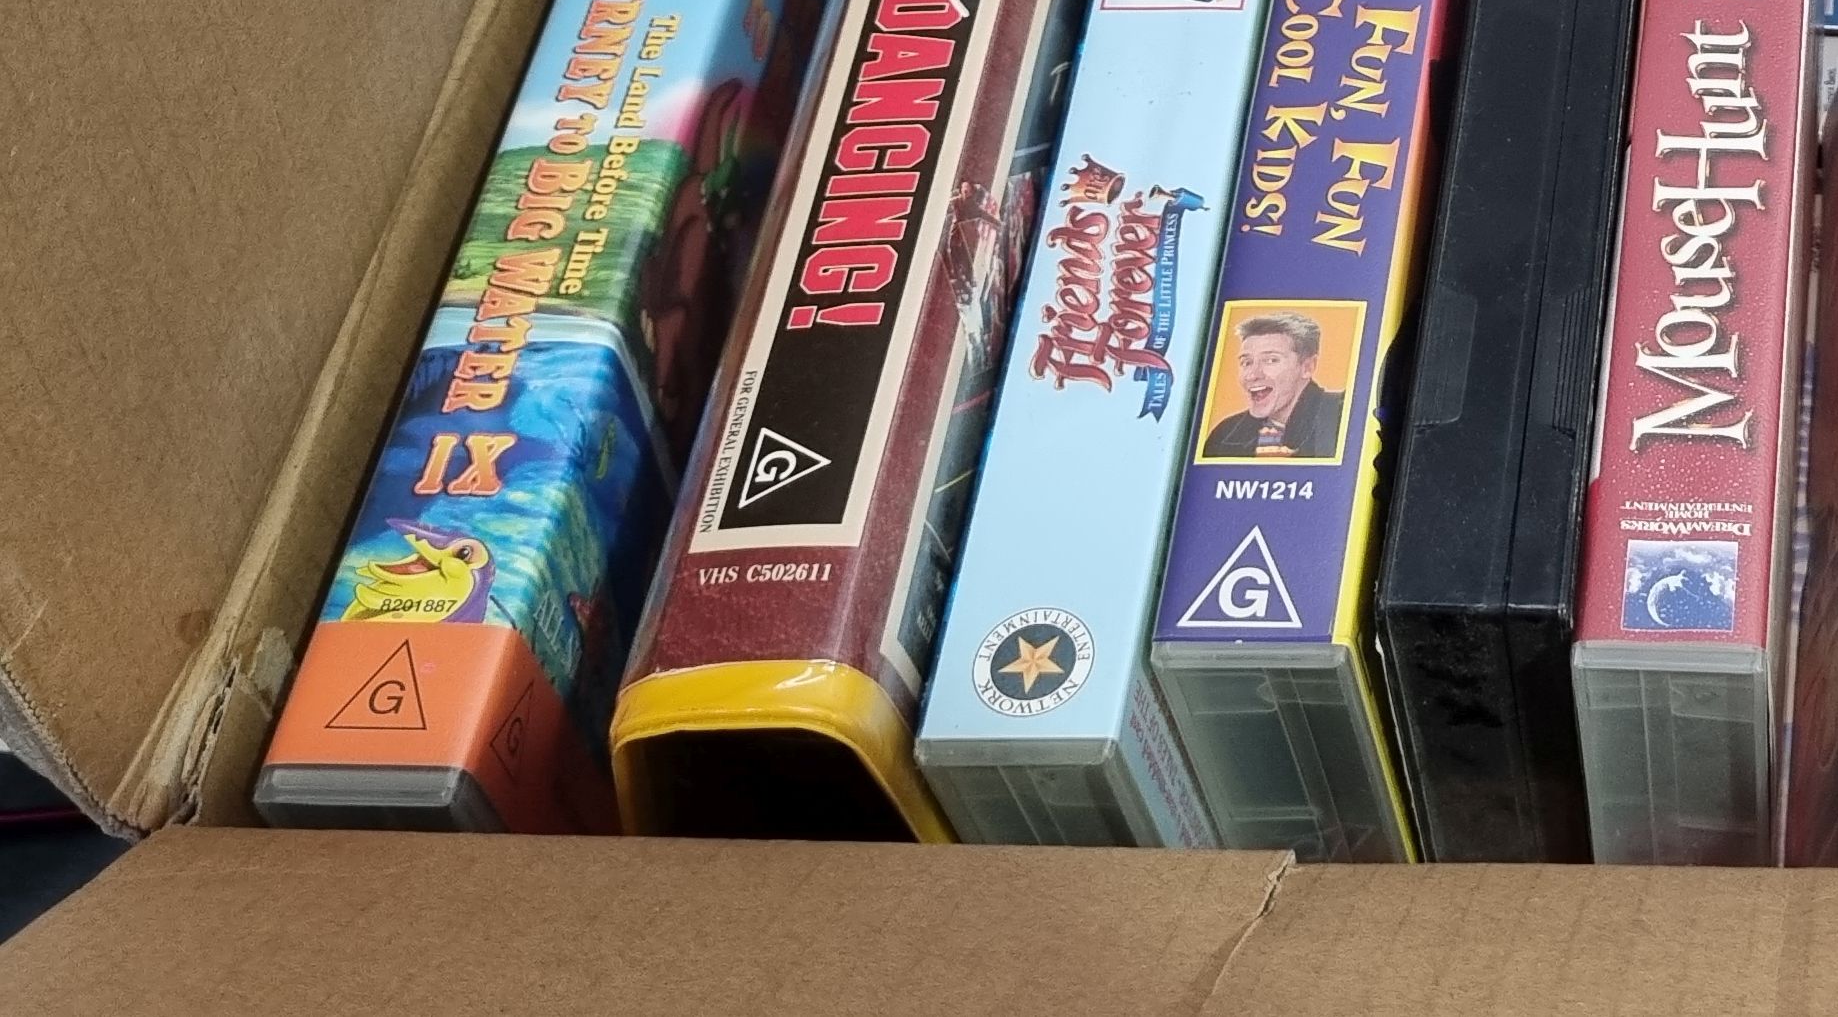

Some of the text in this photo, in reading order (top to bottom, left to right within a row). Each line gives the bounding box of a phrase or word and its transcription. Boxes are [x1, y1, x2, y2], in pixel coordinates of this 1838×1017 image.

[547, 113, 598, 154] TO
[558, 14, 682, 295] The Land Before Time
[506, 158, 594, 243] BIG
[1628, 19, 1769, 452] MouseHunt
[1029, 205, 1112, 393] Friends
[1090, 191, 1174, 383] Forever
[1149, 213, 1179, 408] TALES OF THE LITTLE PRINCESS
[441, 248, 561, 415] WATER
[413, 432, 518, 496] IX
[699, 371, 758, 534] FOR GENERAL EXHIBITION
[753, 449, 798, 484] G
[1215, 481, 1314, 500] NW1214
[1619, 500, 1753, 515] ENTERTAINMENT
[1664, 509, 1711, 521] HOME
[699, 563, 832, 585] VHS C502611
[1218, 567, 1270, 618] G
[379, 598, 458, 614] 8201887
[978, 609, 1091, 662] ENTERTAINMENT
[368, 679, 406, 715] G
[978, 679, 1079, 715] NETWORK
